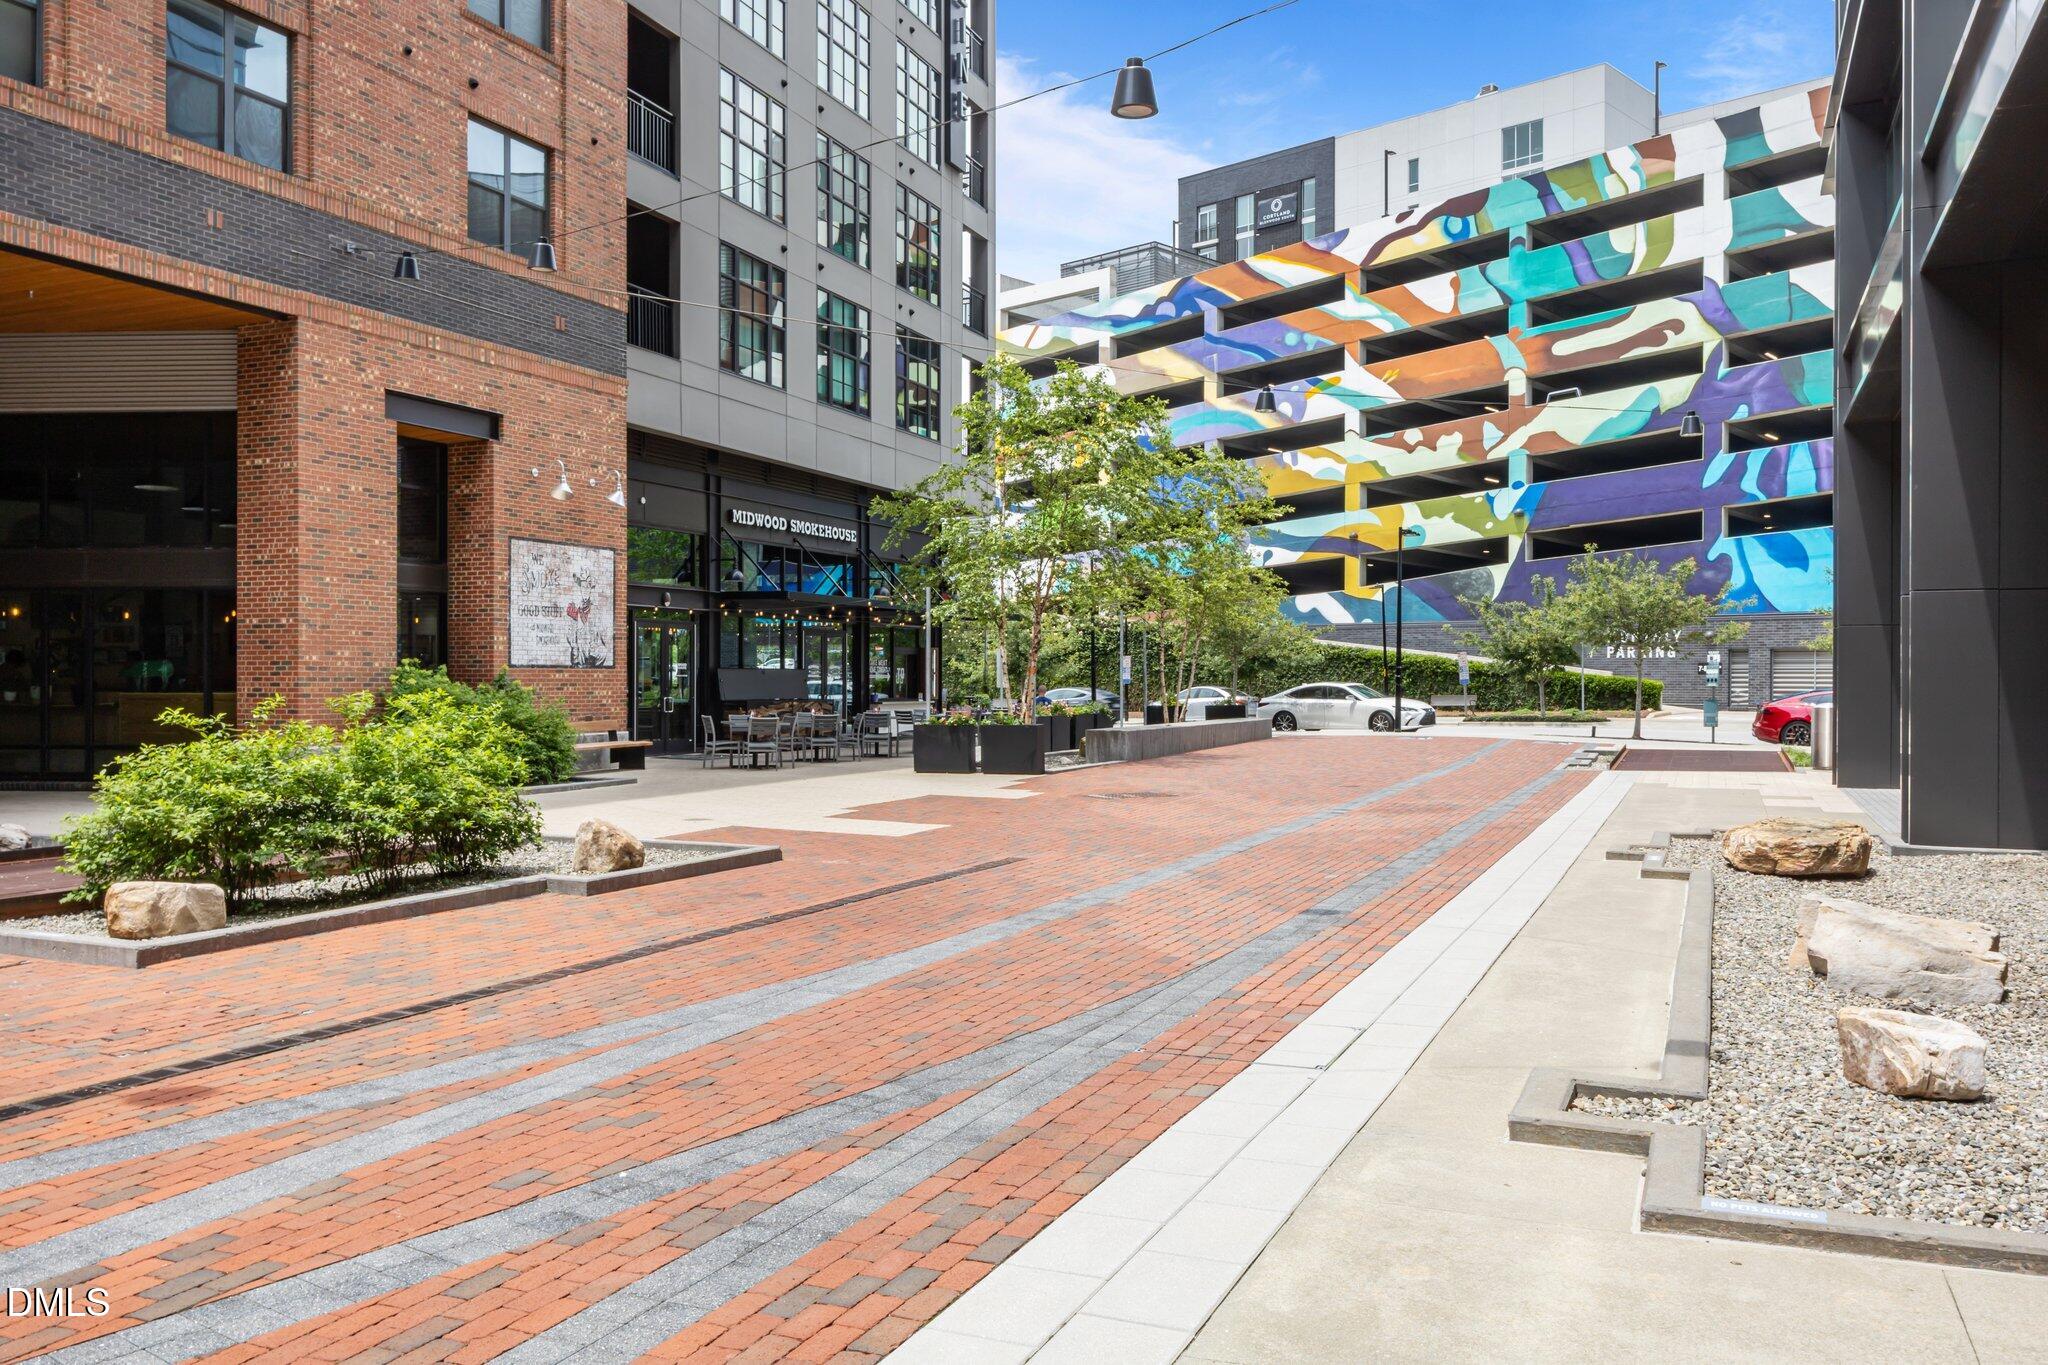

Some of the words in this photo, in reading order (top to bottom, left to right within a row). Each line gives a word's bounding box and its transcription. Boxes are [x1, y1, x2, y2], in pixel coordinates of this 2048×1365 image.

[951, 0, 970, 122] INE
[1262, 209, 1291, 221] CORTLAND
[732, 509, 788, 531] MIDWOOD
[790, 518, 857, 543] SMOKEHOUSE
[1606, 646, 1676, 659] PARING
[1711, 1201, 1727, 1209] NO
[1730, 1203, 1759, 1212] PETS
[1761, 1206, 1819, 1219] ALLOWED
